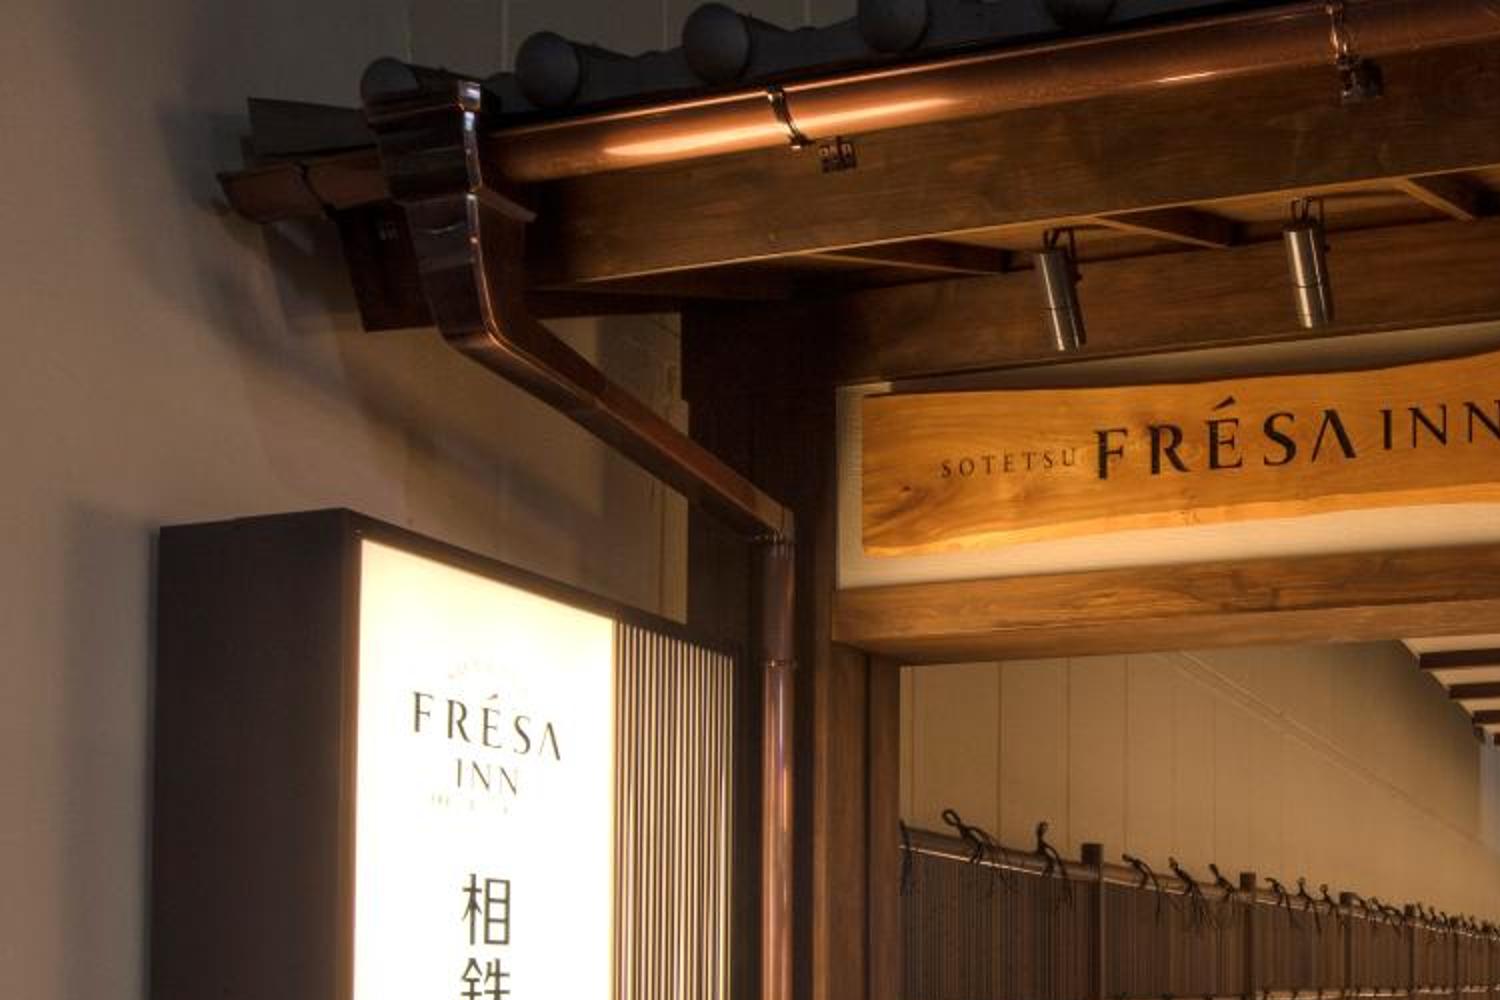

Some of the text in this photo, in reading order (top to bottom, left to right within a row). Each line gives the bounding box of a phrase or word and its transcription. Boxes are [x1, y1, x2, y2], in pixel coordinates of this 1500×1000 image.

[940, 447, 1077, 478] SOTETSU
[1095, 396, 1358, 481] FRÉSA
[413, 690, 562, 762] FRÉSA
[456, 757, 520, 796] INN
